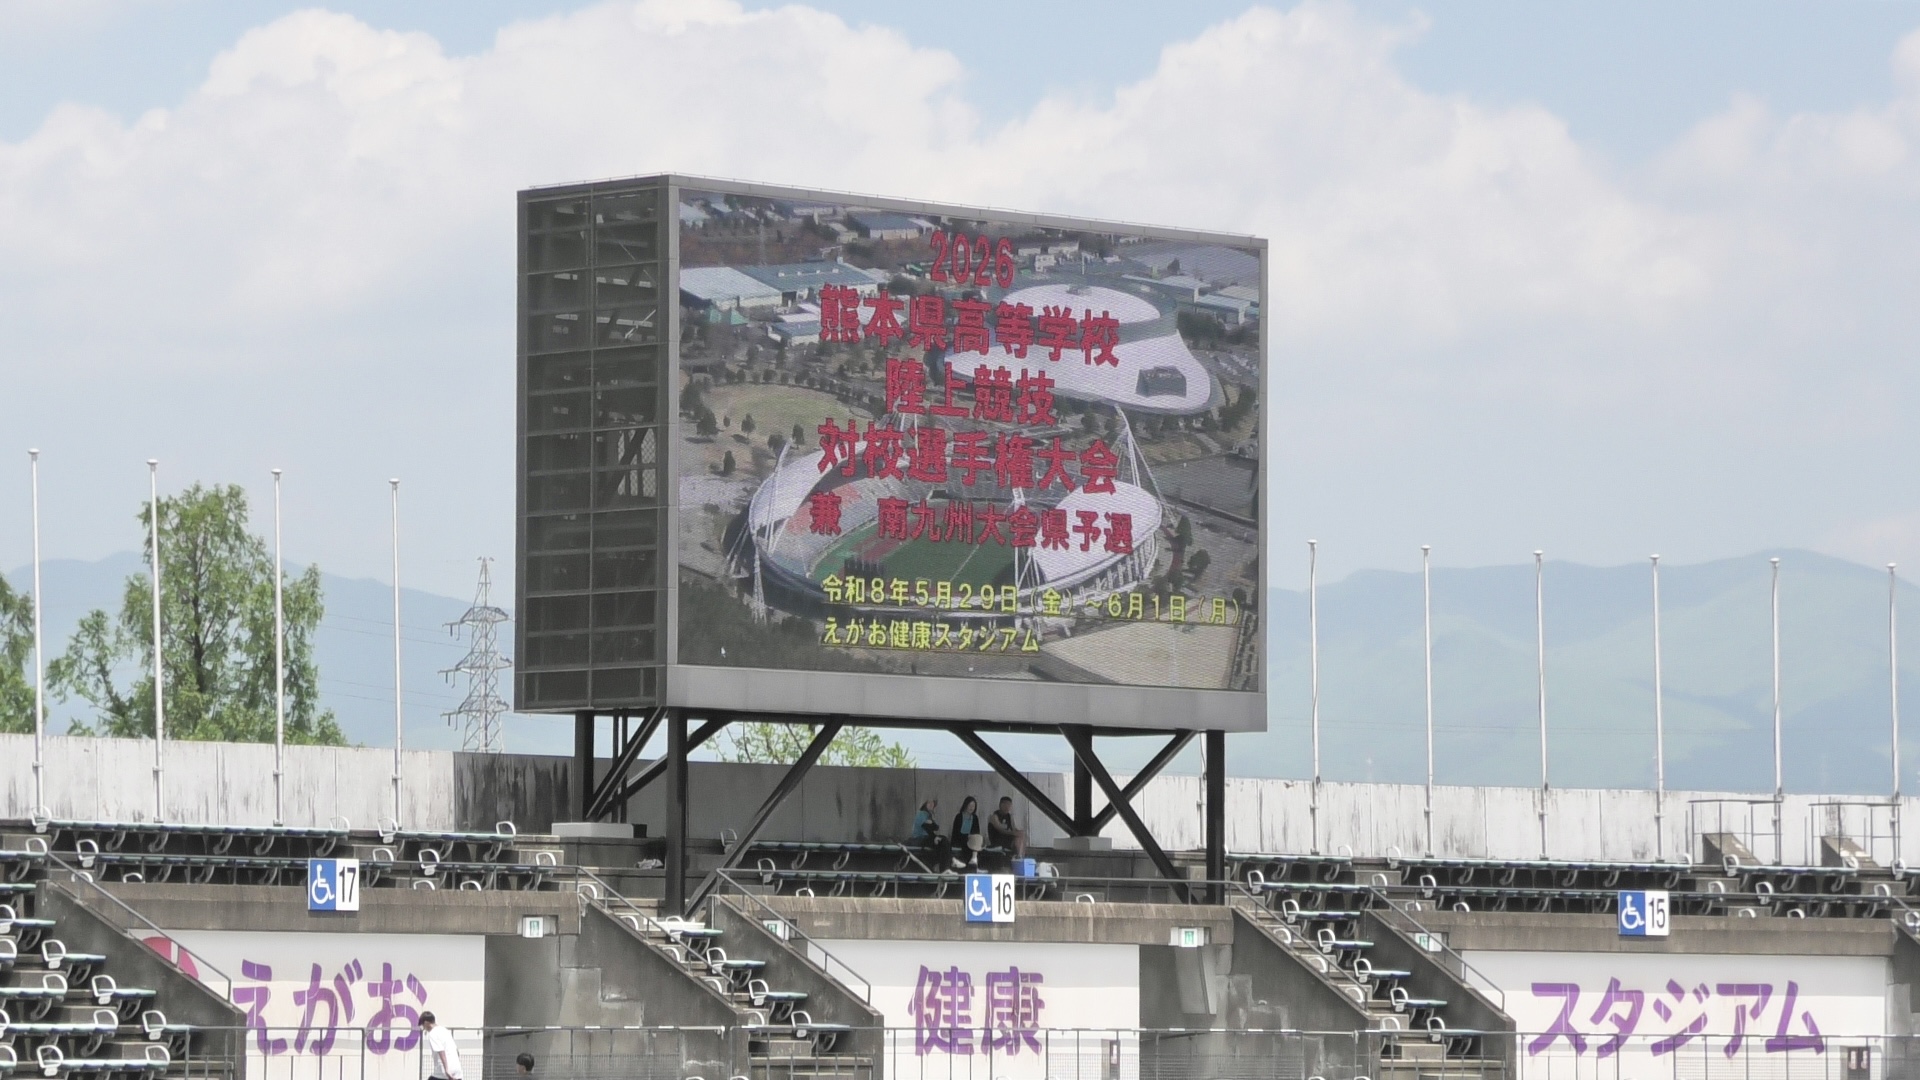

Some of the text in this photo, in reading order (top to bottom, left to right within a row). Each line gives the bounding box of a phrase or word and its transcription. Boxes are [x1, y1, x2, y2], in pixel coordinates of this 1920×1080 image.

[930, 230, 1015, 289] 2026
[819, 283, 1120, 368] 熊本県高等学校
[886, 358, 1055, 427] 陸上競技
[817, 417, 1118, 495] 対校選手権大会
[809, 490, 1134, 554] 兼 南九州大会県予選
[824, 616, 1040, 652] えがお健康スタジアム
[339, 866, 356, 903] 17
[995, 882, 1012, 915] 16
[1648, 897, 1665, 929] 15
[233, 958, 427, 1055] えがお
[908, 965, 1045, 1056] 健康
[1528, 976, 1825, 1059] スタジアム
